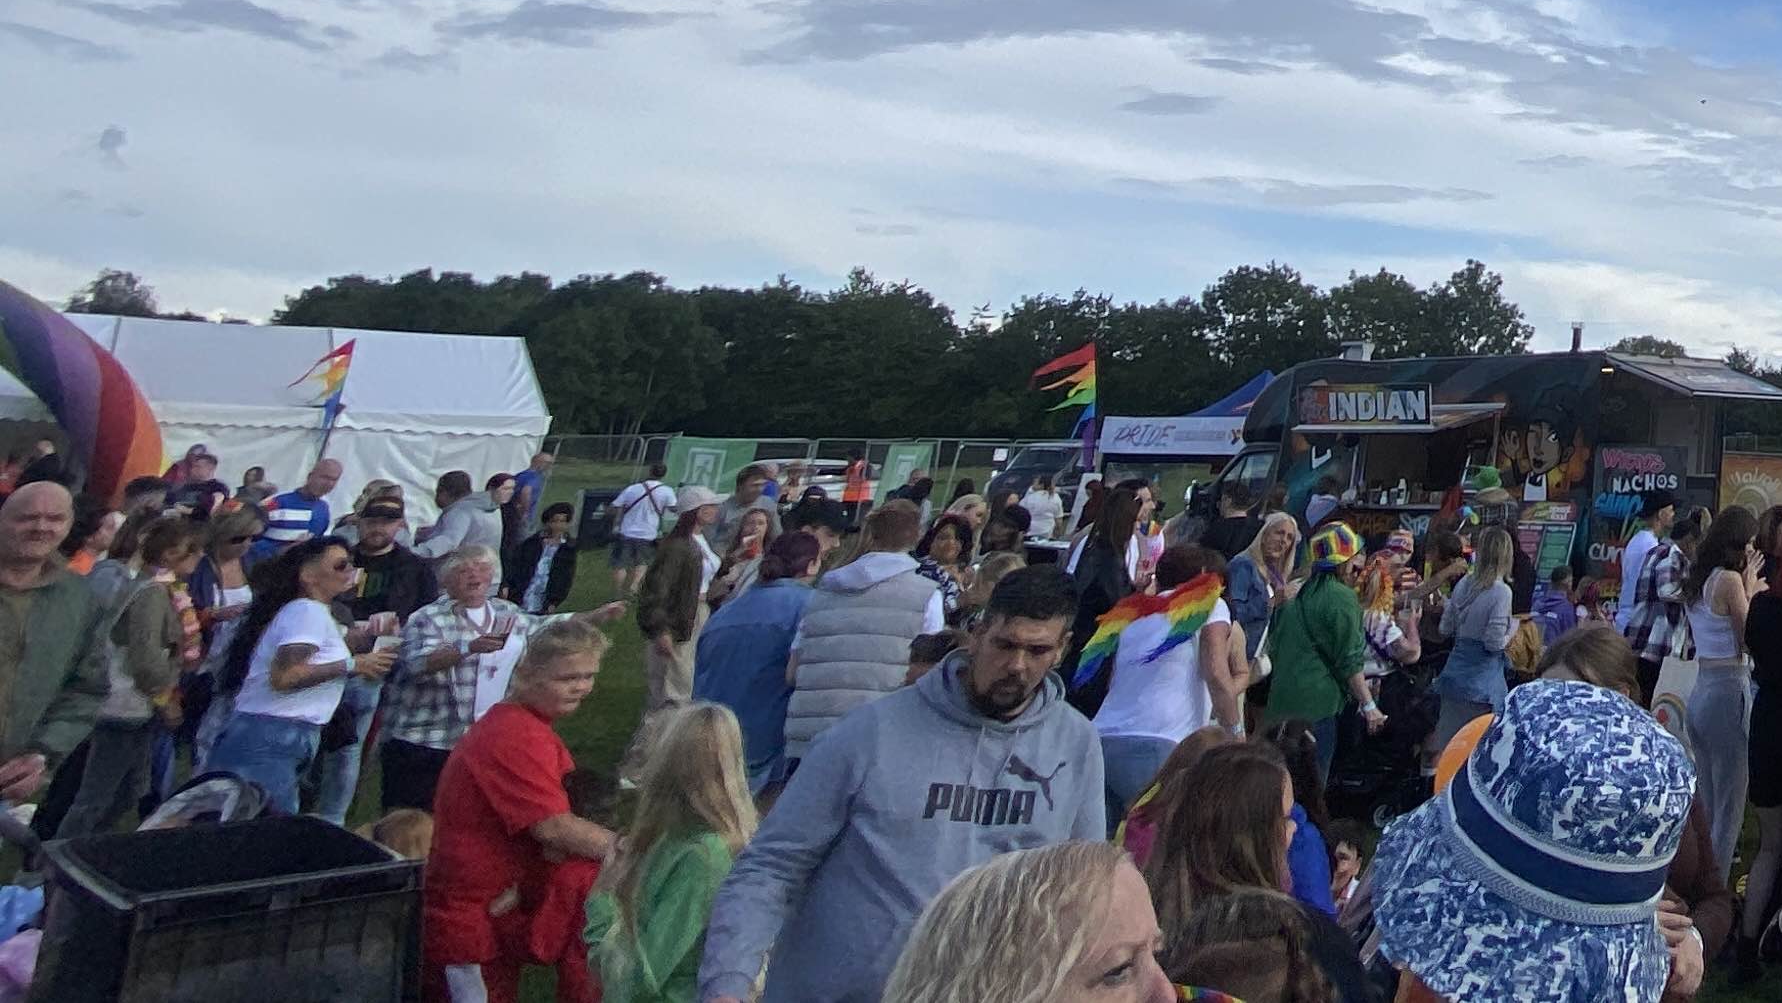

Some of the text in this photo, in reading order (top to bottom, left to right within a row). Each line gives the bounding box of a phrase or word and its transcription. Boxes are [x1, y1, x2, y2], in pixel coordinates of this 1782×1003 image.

[1328, 390, 1426, 421] INDIAN
[1612, 473, 1678, 494] NACHOS
[922, 782, 1037, 826] PUMA
